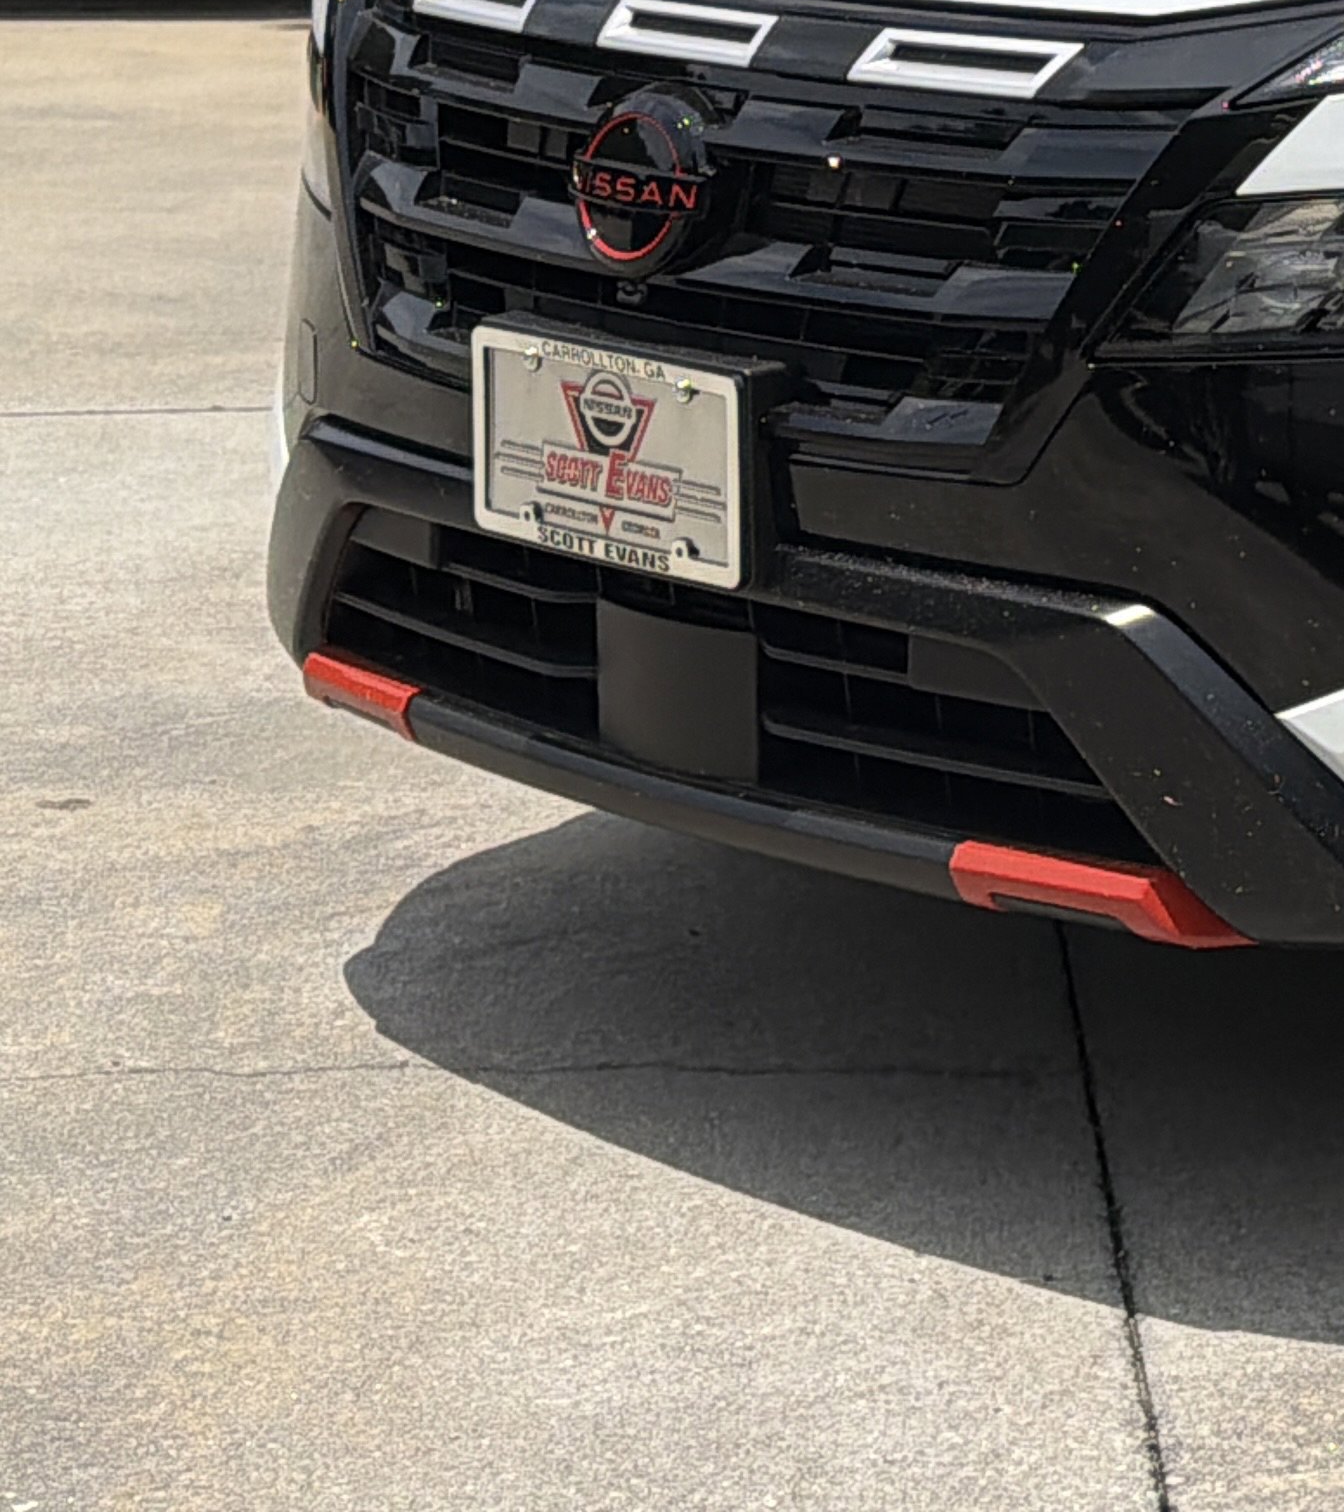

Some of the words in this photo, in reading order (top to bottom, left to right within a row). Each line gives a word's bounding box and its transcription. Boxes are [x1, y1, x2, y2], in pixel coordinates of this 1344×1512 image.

[643, 360, 666, 381] GA
[582, 397, 633, 420] NISSAN
[545, 450, 603, 492] SCOTT
[604, 448, 673, 507] EVANS
[537, 525, 598, 555] SCOTT
[603, 541, 670, 573] EVANS
